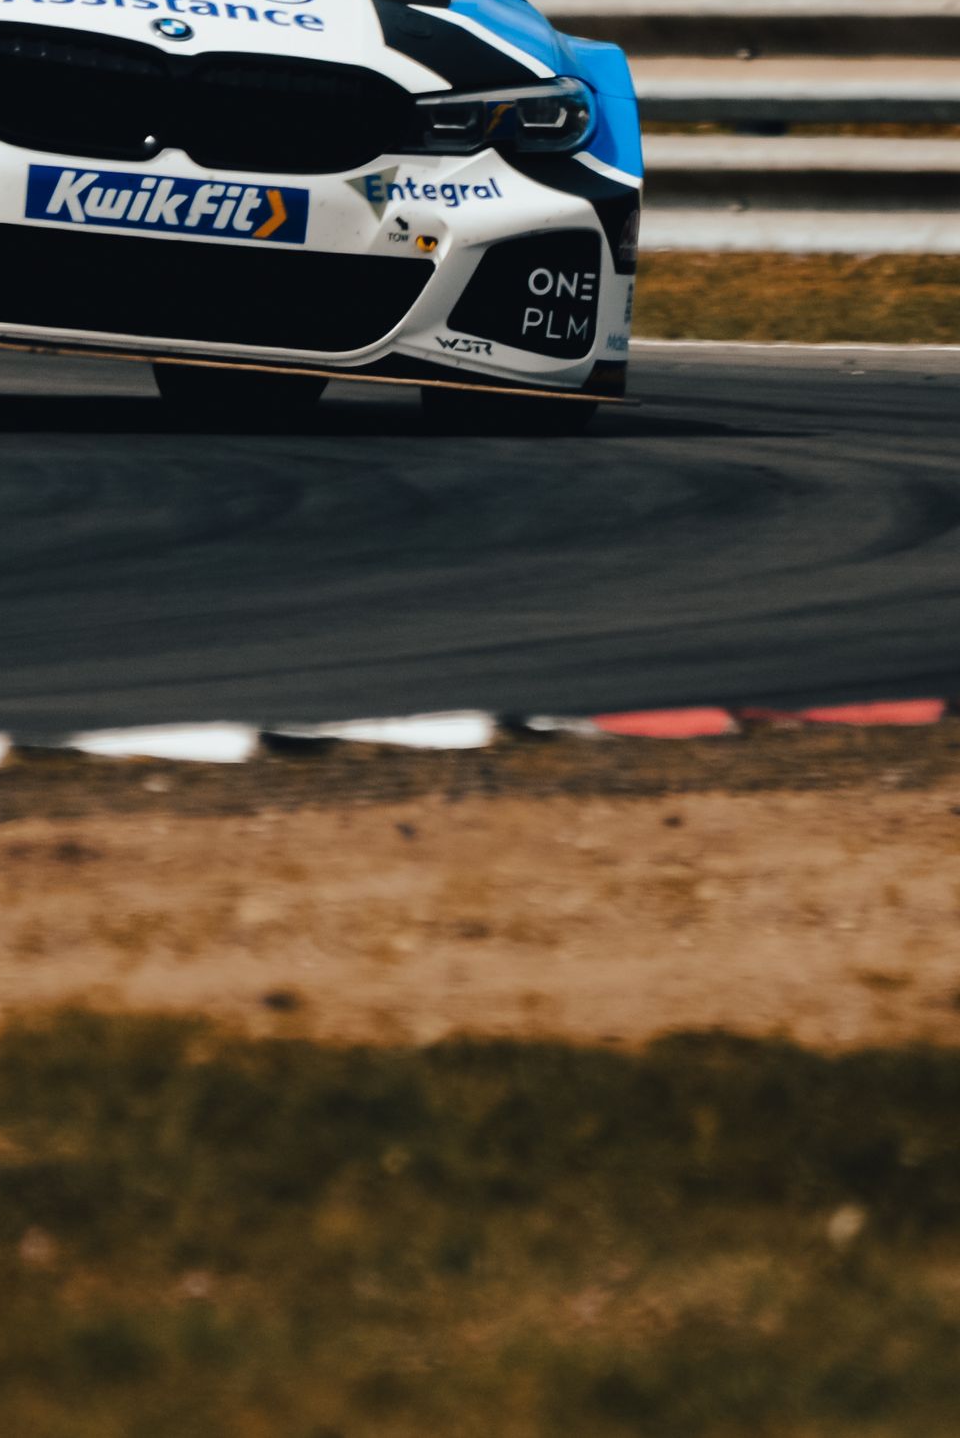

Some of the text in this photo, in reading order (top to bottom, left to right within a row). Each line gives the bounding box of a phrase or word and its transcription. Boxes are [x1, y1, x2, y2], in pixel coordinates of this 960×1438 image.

[364, 173, 504, 209] Entegral
[387, 232, 410, 243] TOW
[527, 267, 597, 301] ONE
[522, 307, 590, 341] PLM
[434, 336, 494, 355] WSR
